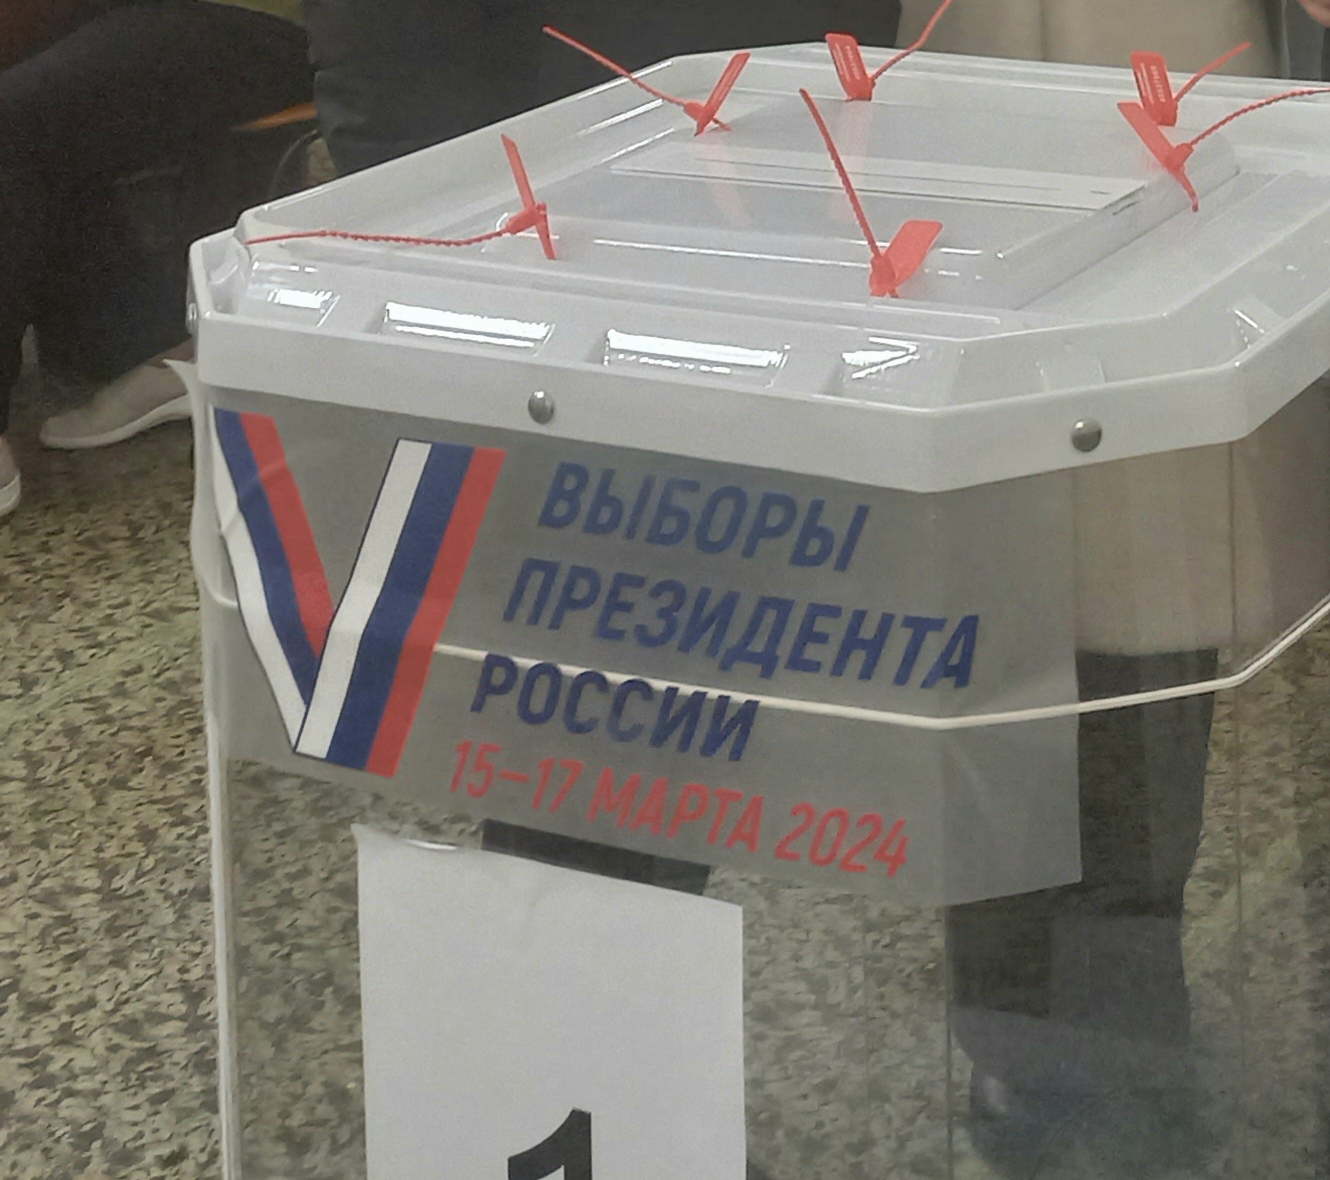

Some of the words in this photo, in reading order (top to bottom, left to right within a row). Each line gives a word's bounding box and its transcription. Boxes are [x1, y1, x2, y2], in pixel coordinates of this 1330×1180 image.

[537, 461, 870, 573] ВЫБОРЫ
[502, 557, 981, 690] ПРЕЗИДЕНТА
[470, 652, 761, 762] РОССИИ
[586, 766, 766, 855] МАРТА
[774, 801, 909, 879] 2024
